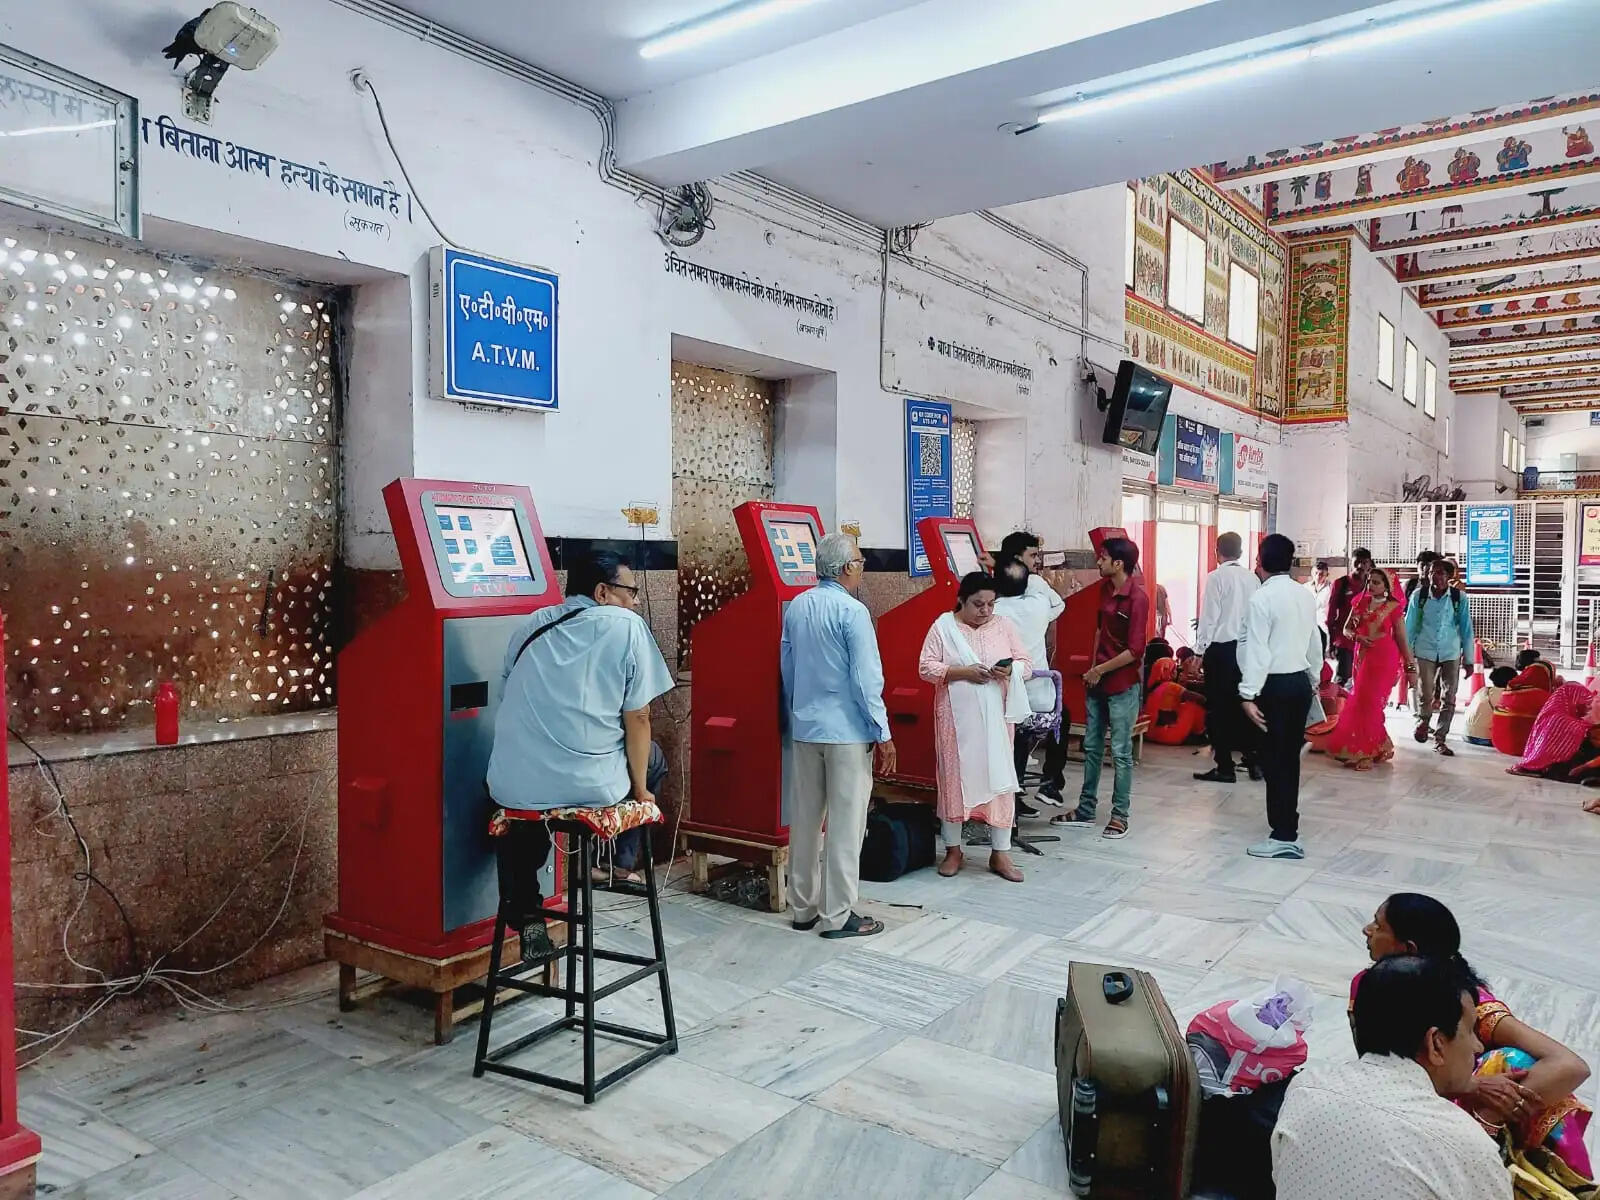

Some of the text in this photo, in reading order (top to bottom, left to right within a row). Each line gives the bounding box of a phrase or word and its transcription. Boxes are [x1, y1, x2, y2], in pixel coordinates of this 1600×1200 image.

[156, 115, 220, 164] बिताना
[223, 141, 276, 178] आत्म
[280, 157, 321, 192] हत्या
[320, 160, 340, 196] के
[340, 174, 386, 211] समान
[688, 261, 709, 284] समय
[471, 341, 540, 371] A.T.V.M.
